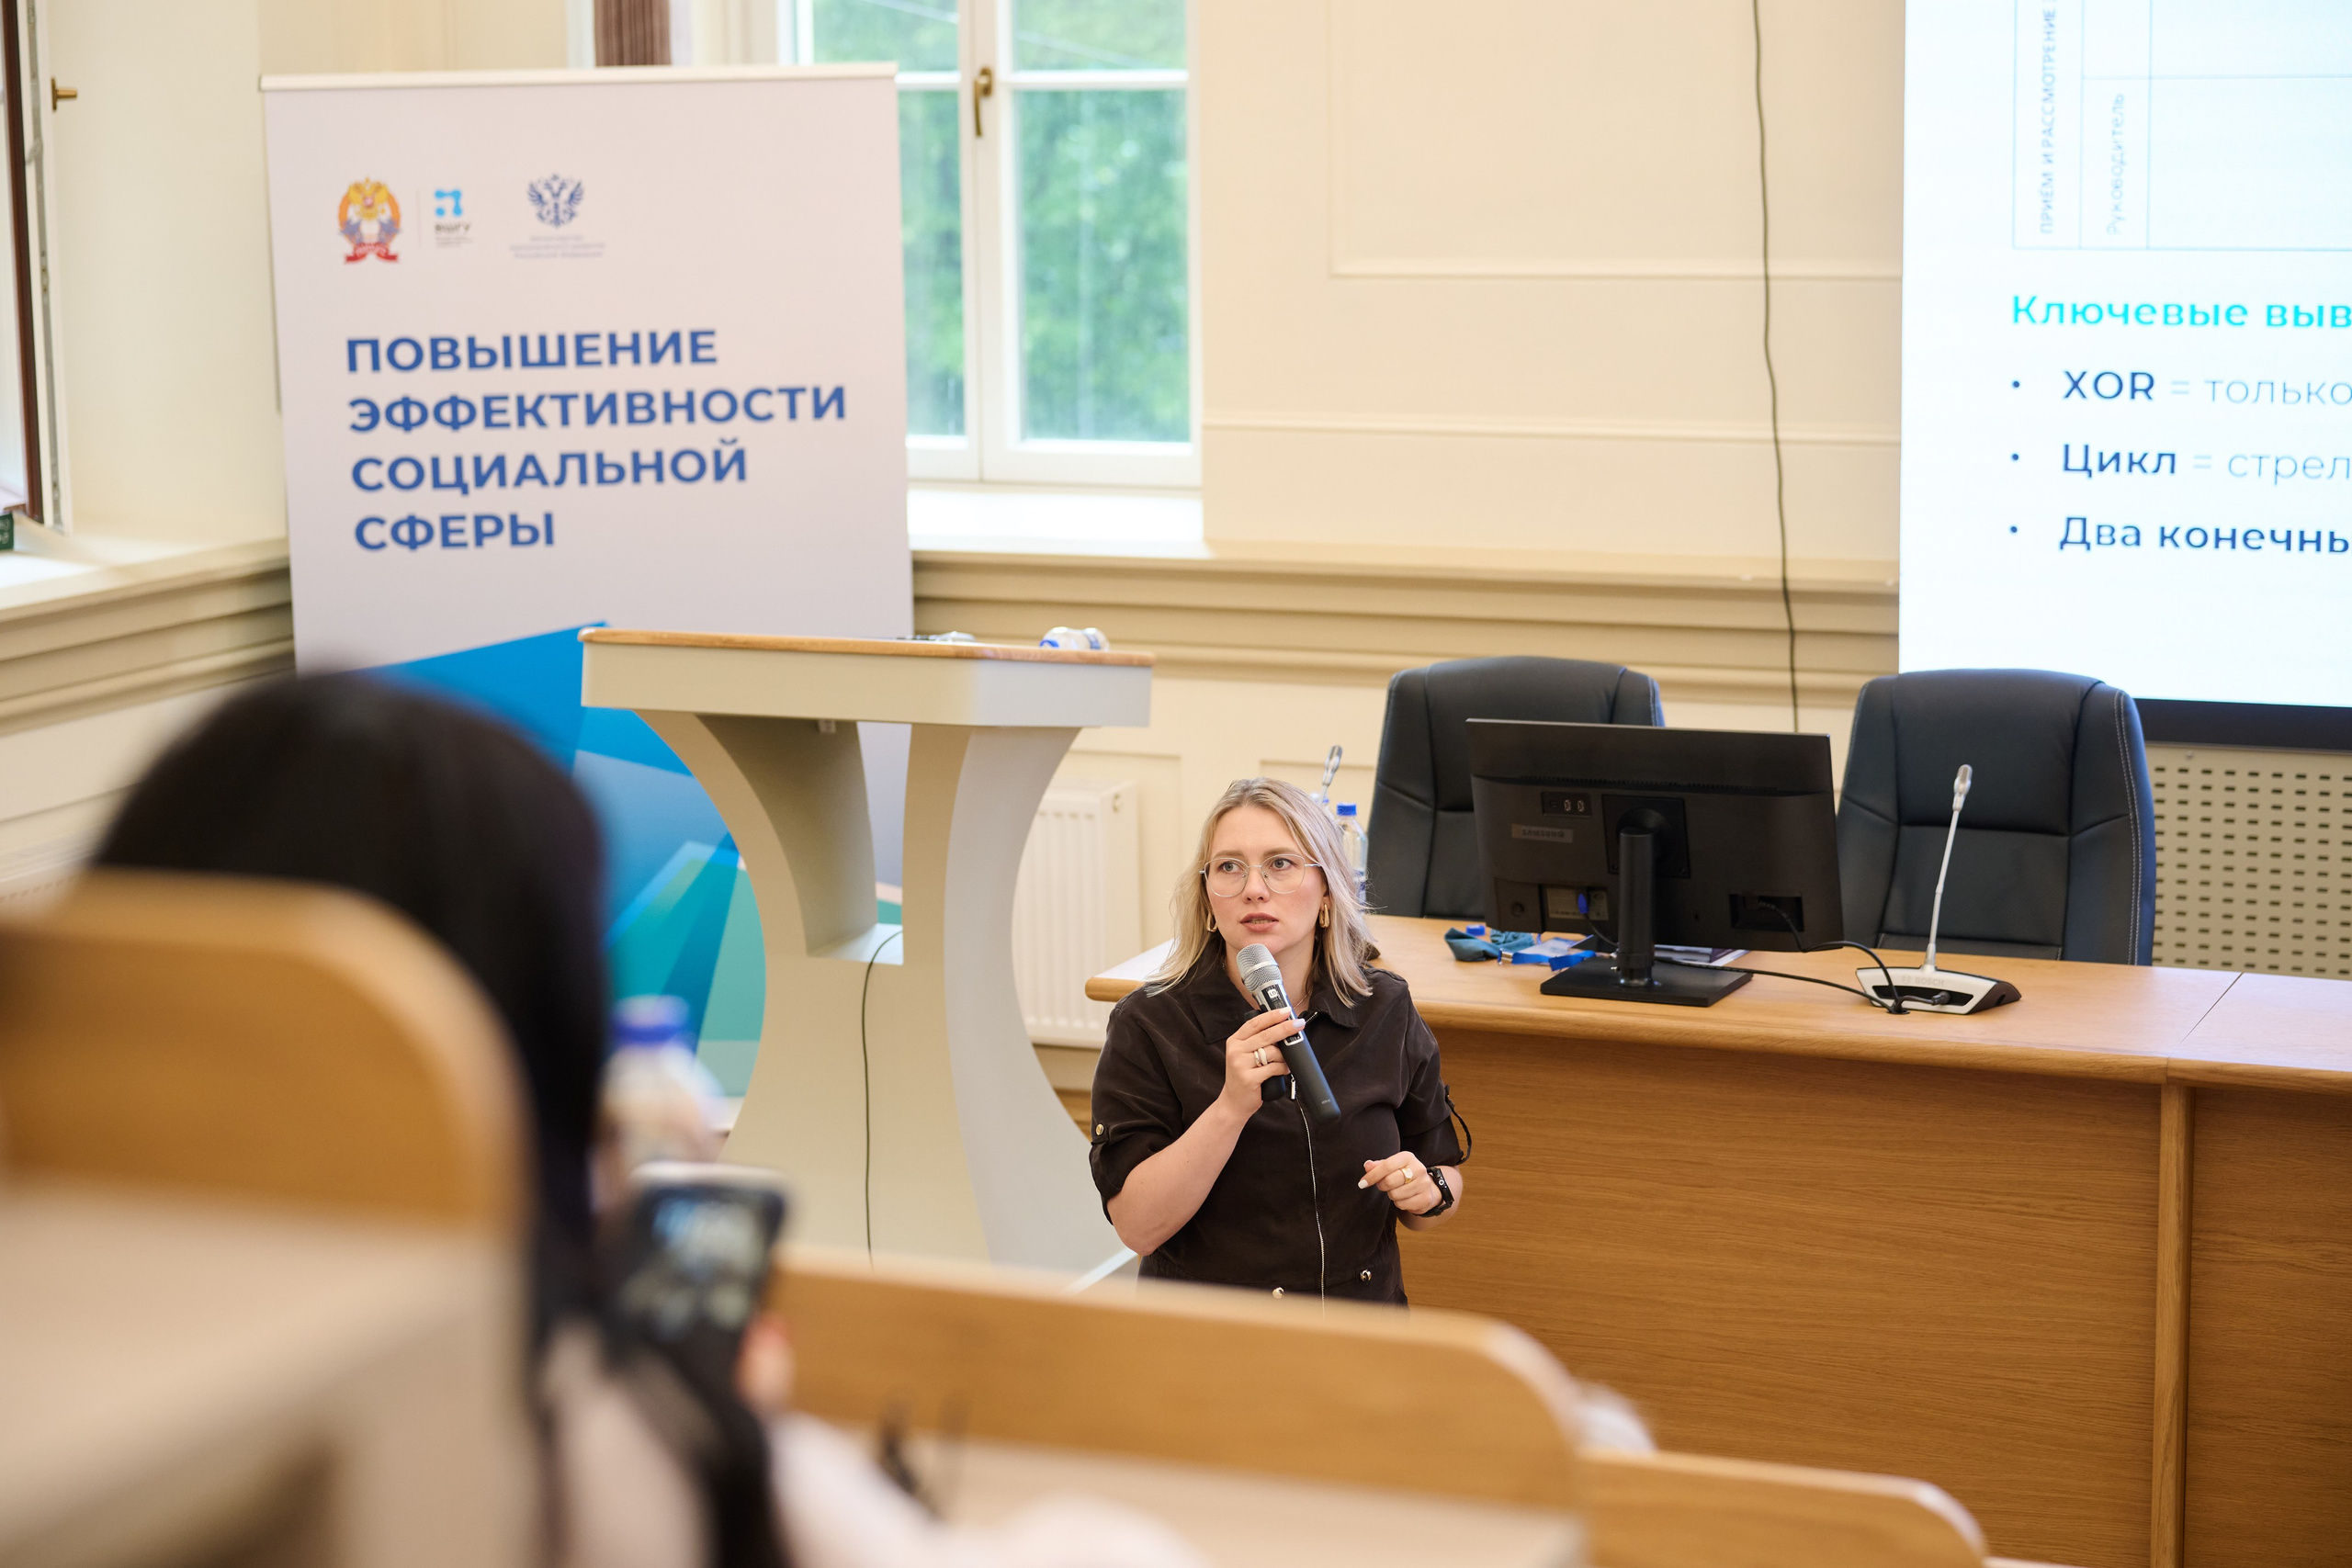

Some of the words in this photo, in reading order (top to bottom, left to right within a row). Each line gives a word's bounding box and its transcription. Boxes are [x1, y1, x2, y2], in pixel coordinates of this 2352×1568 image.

[2041, 9, 2057, 149] РАССМОТРЕНИЕ
[2041, 153, 2054, 164] И
[2106, 93, 2127, 235] Руководитель
[2012, 295, 2248, 328] Ключевые
[2265, 304, 2352, 328] выв
[345, 330, 718, 374] ПОВЫШЕНИЕ
[2064, 370, 2154, 401] XOR
[2205, 379, 2352, 405] только
[347, 386, 846, 434] ЭФФЕКТИВНОСТИ
[351, 437, 747, 496] СОЦИАЛЬНОЙ
[2063, 444, 2177, 479] Цикл
[2227, 454, 2351, 486] стрел
[355, 512, 555, 552] СФЕРЫ
[2059, 516, 2141, 552] Два
[1521, 829, 1565, 838] SAMSUNG
[1916, 977, 1945, 987] BOSCH
